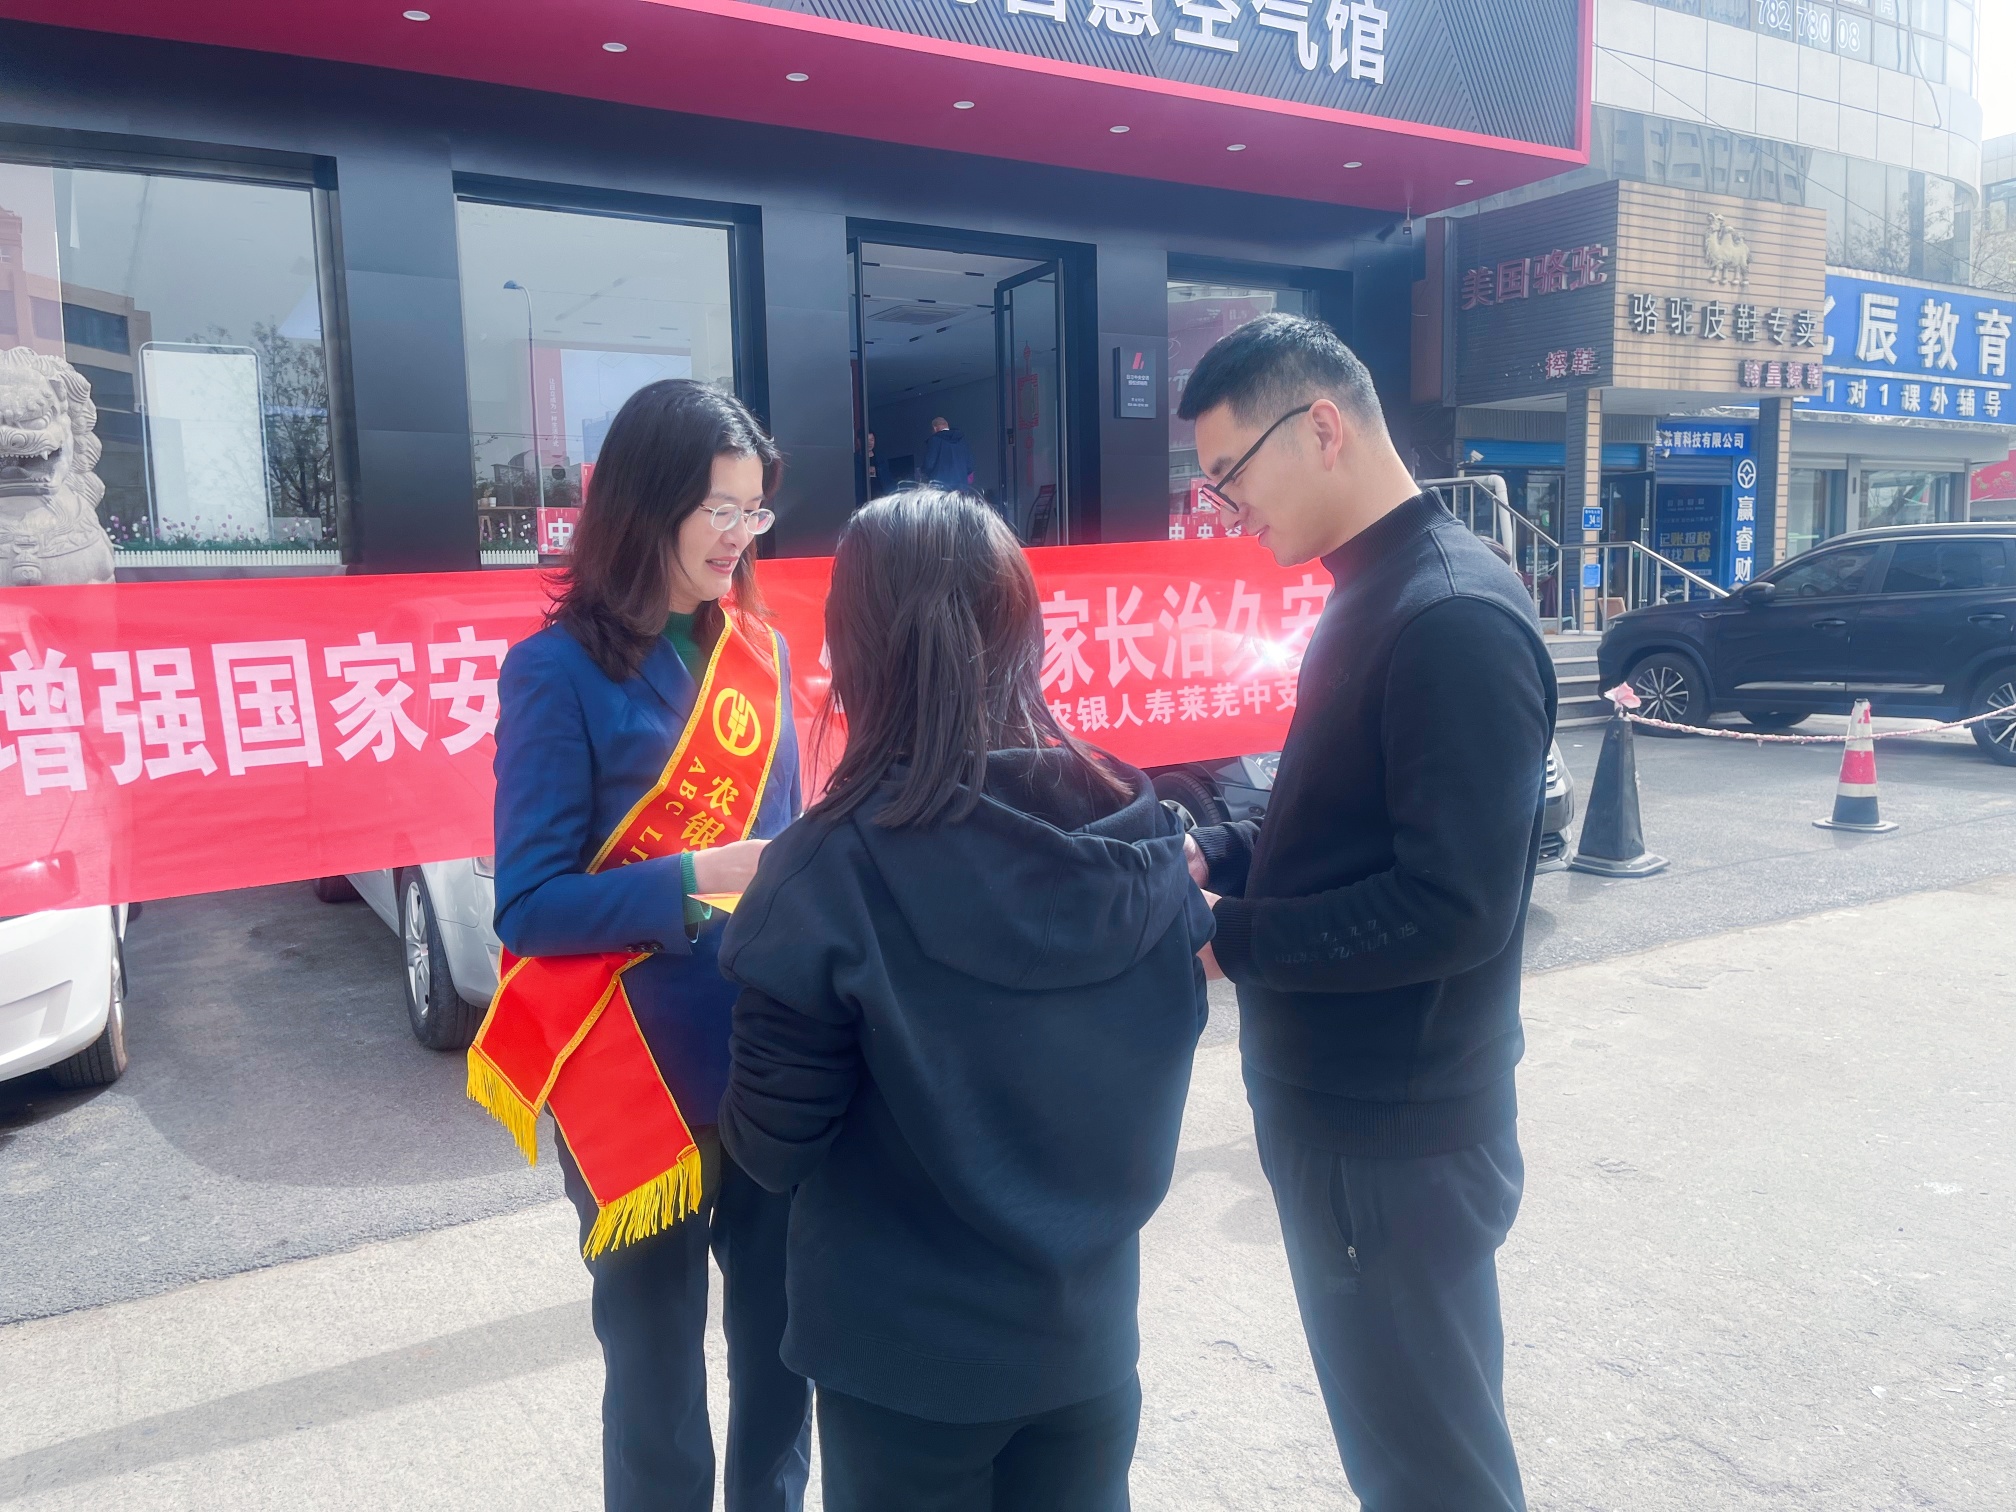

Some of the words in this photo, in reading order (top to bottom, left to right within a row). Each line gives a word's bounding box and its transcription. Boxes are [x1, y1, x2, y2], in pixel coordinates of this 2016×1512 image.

[1008, 0, 1389, 85] 空气馆
[1461, 243, 1608, 310] 美国骆驼
[1630, 293, 1819, 348] 骆驼皮鞋专卖
[1546, 347, 1596, 380] 擦鞋
[1793, 379, 2002, 417] 1对1课外辅导
[1734, 496, 1755, 582] 赢睿财
[0, 626, 510, 796] 增强国家安
[621, 825, 663, 866] LI
